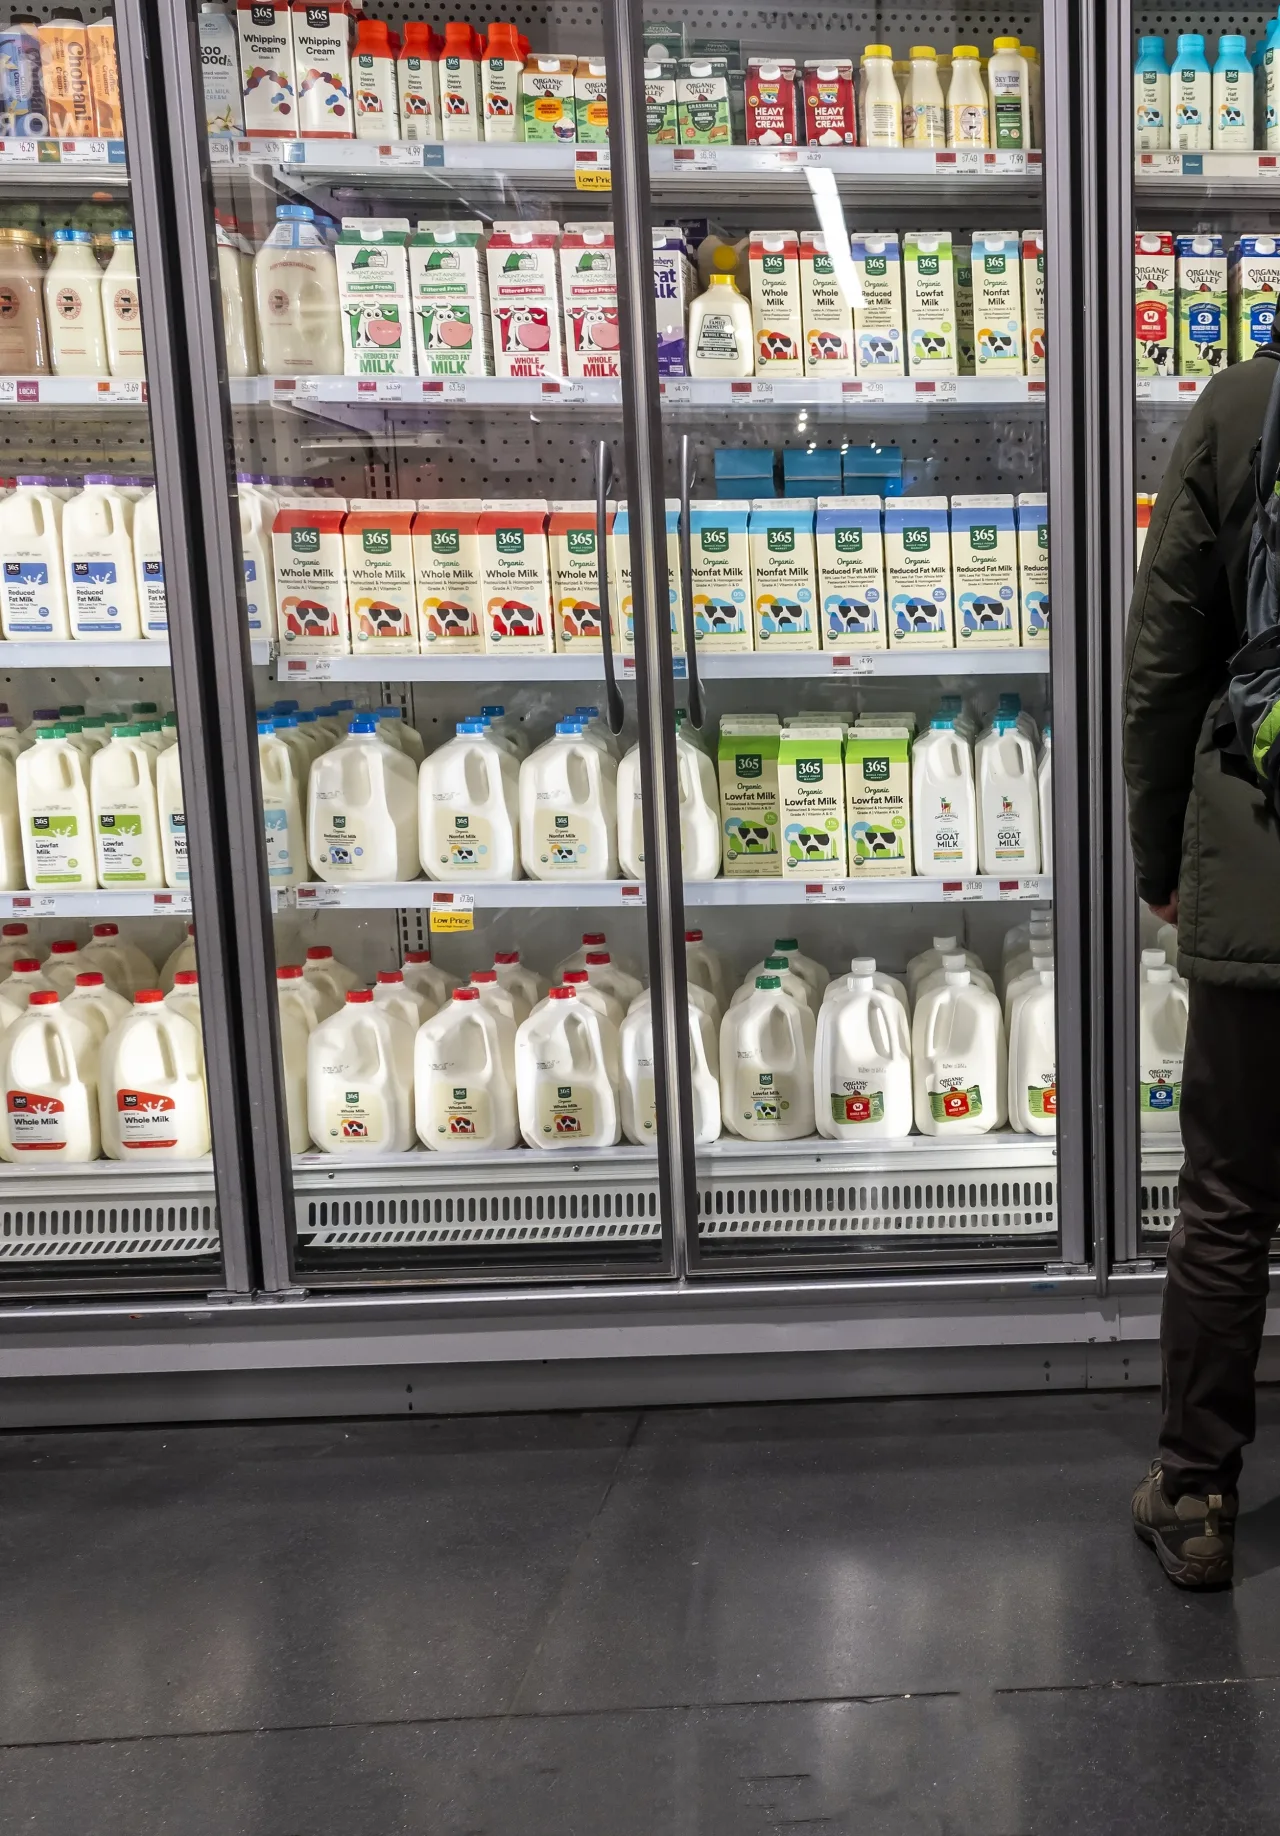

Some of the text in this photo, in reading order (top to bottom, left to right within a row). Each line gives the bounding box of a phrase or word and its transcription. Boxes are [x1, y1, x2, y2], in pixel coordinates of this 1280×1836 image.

[253, 7, 273, 19] 365
[308, 10, 327, 21] 365
[244, 35, 286, 45] Whipping
[299, 37, 341, 48] Whipping
[251, 45, 280, 54] Cream
[306, 46, 335, 56] Cream
[360, 56, 372, 64] 365
[66, 41, 91, 122] Chobani
[532, 78, 564, 88] ORGANIC
[995, 75, 1019, 83] SKY TOP
[538, 82, 561, 91] VALLEY
[756, 120, 784, 128] CREAM
[595, 176, 611, 184] Pric
[764, 257, 782, 268] 365
[985, 255, 1004, 267] 365
[1186, 269, 1223, 278] ORGANIC
[762, 279, 786, 288] Organic
[983, 279, 1007, 287] Organic
[1190, 276, 1220, 284] VALLEY
[360, 360, 395, 373] MILK
[511, 365, 544, 376] MILK
[584, 364, 618, 376] MILK
[499, 532, 521, 544] 365
[769, 531, 792, 543] 365
[838, 531, 859, 543] 365
[498, 559, 524, 568] Organic
[769, 558, 794, 566] Organic
[837, 558, 863, 567] Organic
[75, 563, 87, 571] 365
[788, 568, 808, 576] Milk
[799, 763, 820, 775] 365
[798, 788, 822, 796] Organic
[433, 917, 470, 925] Low Price
